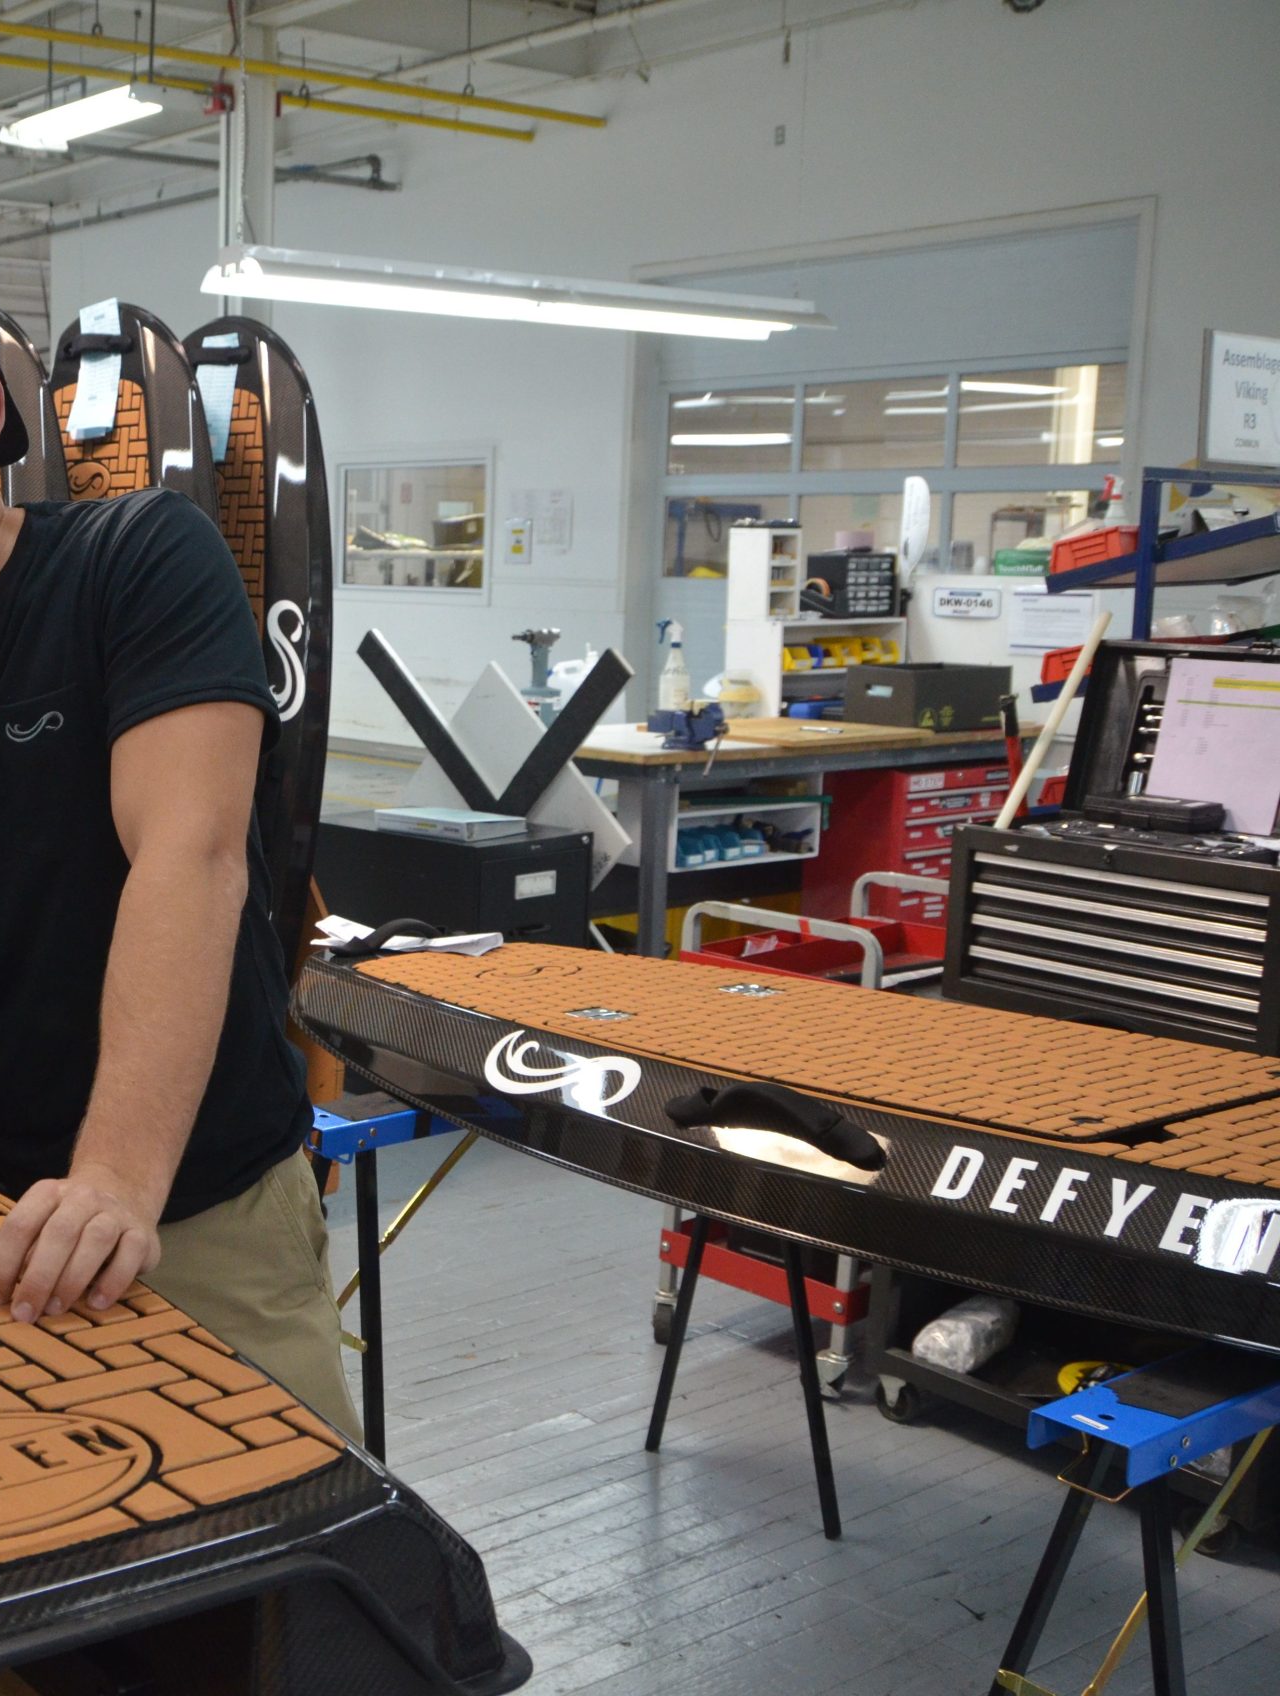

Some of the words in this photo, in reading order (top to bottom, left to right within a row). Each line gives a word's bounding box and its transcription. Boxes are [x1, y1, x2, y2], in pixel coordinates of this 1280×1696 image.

[1234, 380, 1269, 405] Viking
[1243, 412, 1257, 430] R3
[939, 597, 994, 609] DKW-0146
[930, 1144, 1280, 1275] DEFYEN
